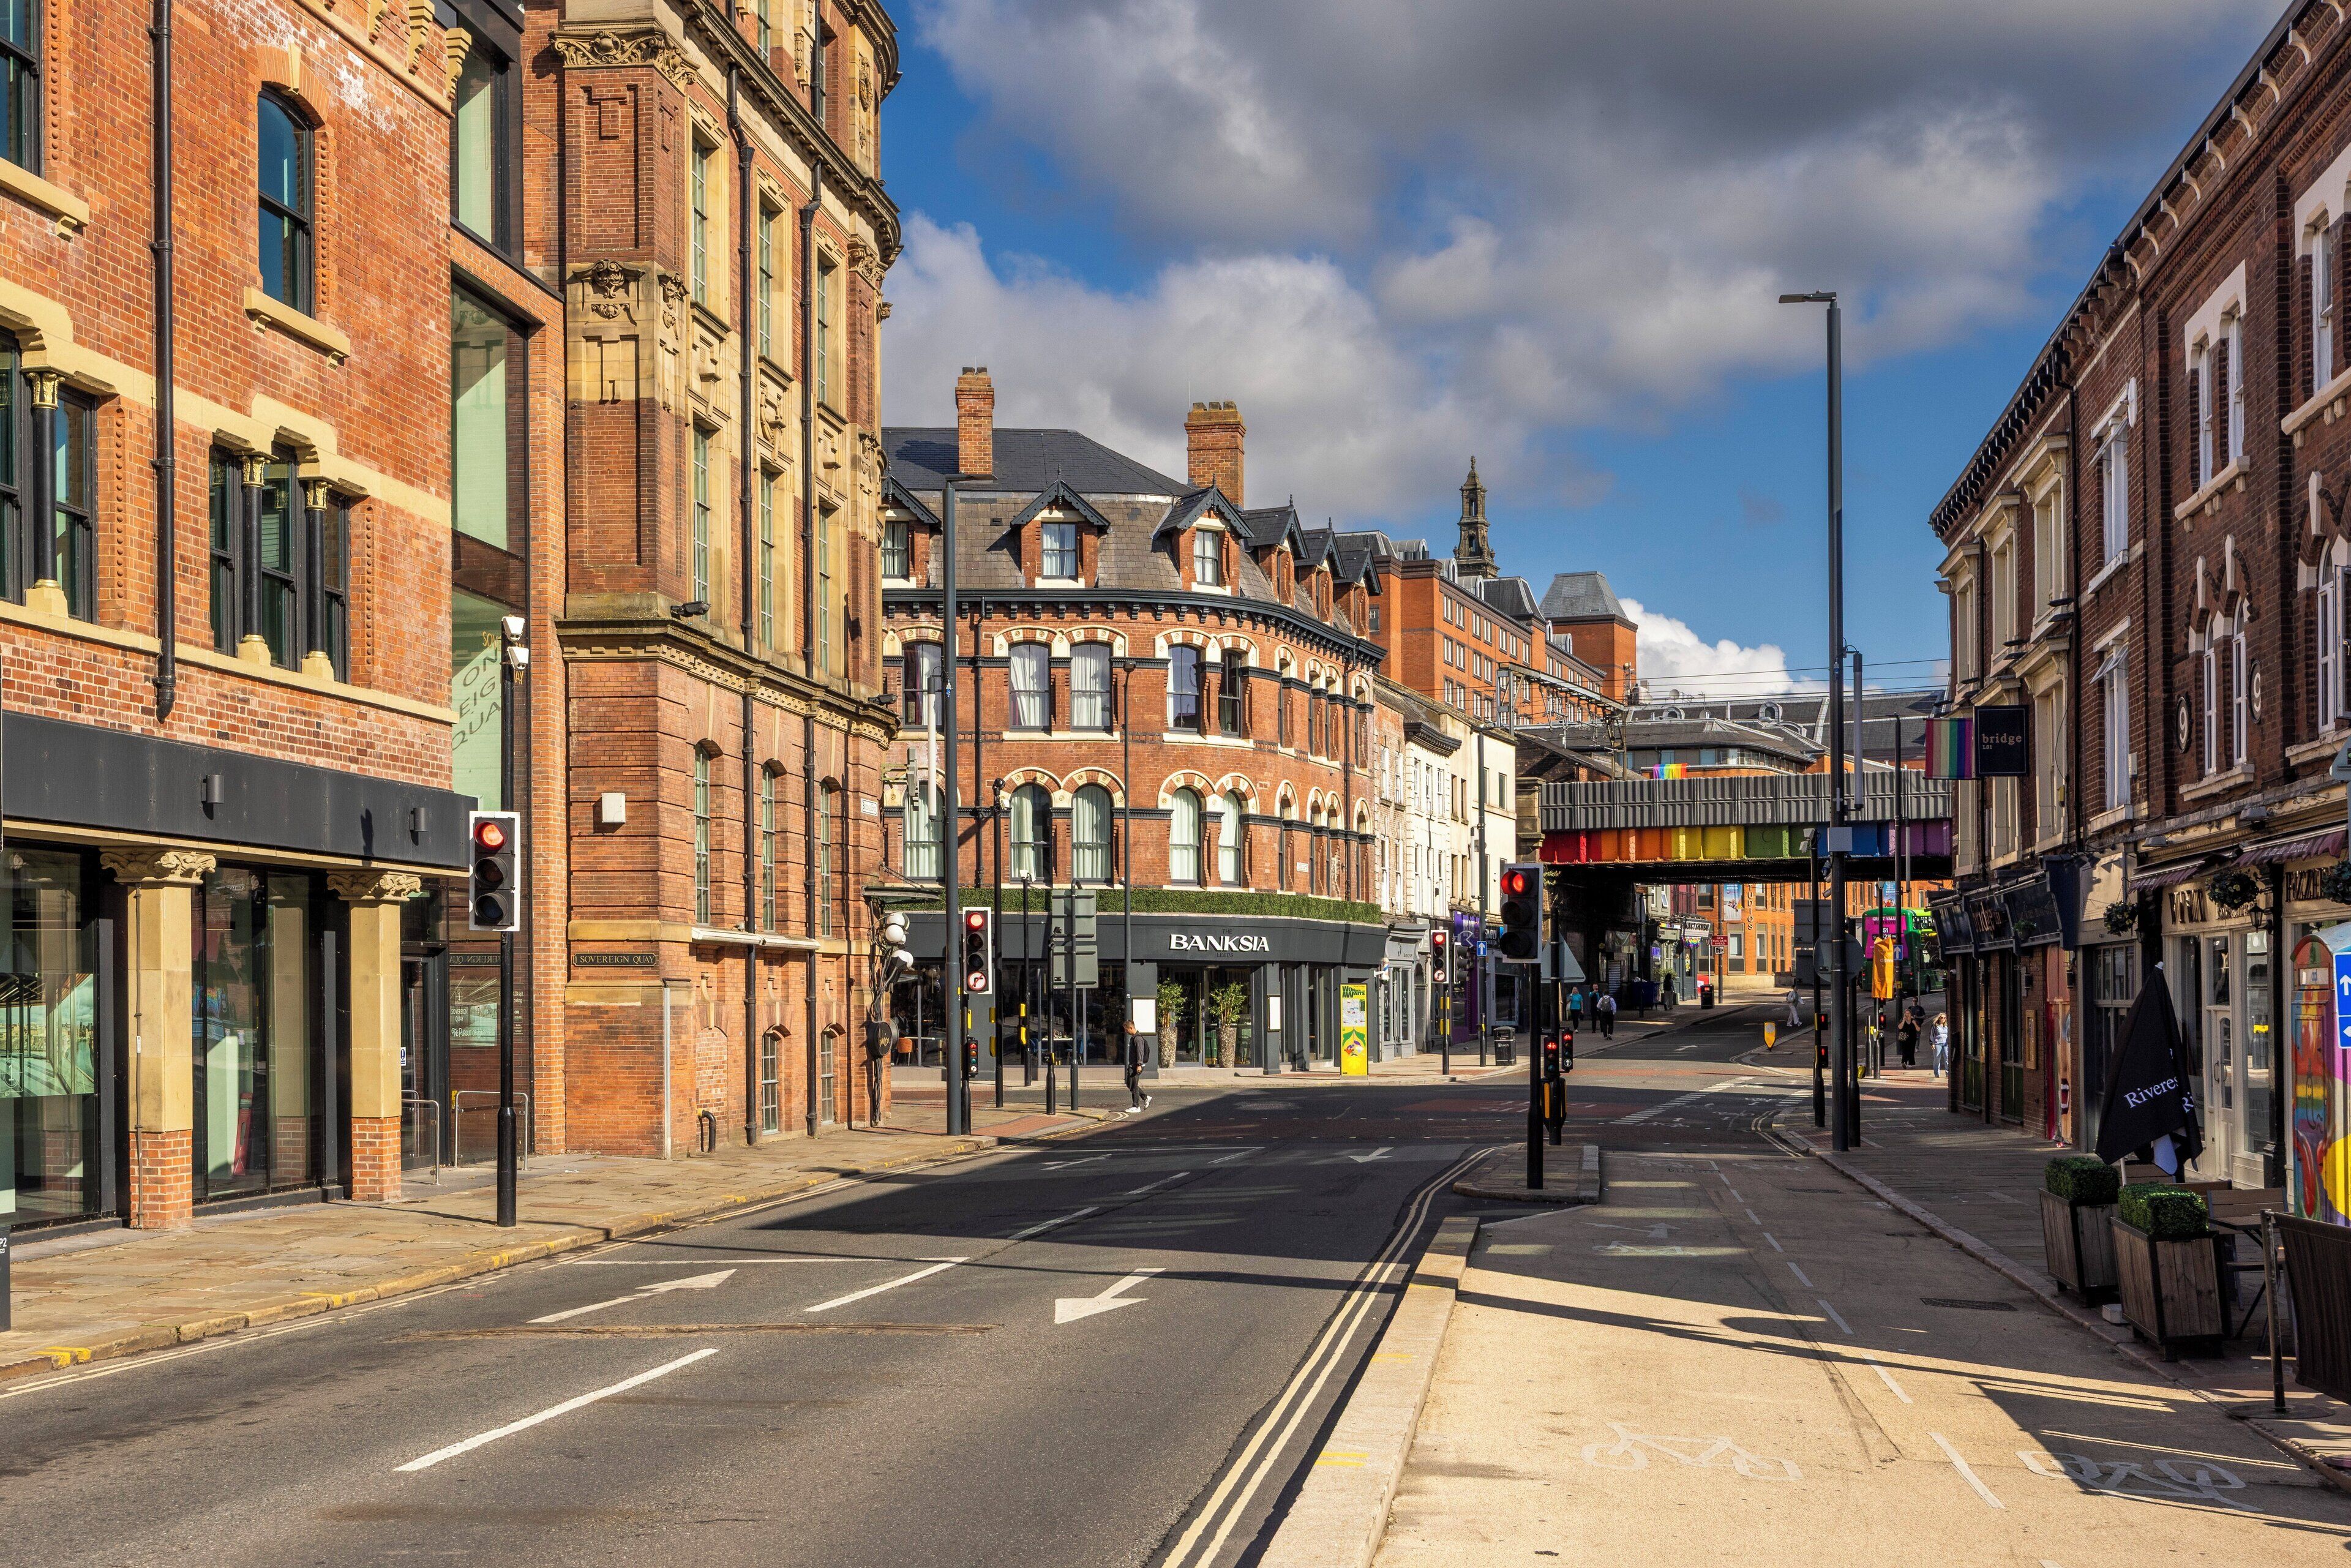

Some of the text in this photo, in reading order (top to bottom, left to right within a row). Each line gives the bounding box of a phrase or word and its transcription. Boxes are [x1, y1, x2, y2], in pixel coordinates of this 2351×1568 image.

[2253, 672, 2261, 712] 9
[452, 701, 501, 751] QUA
[1981, 733, 2022, 745] bridge
[2179, 706, 2189, 744] 9
[2285, 866, 2323, 902] PIZZE
[2169, 888, 2207, 925] VIVA
[580, 955, 631, 964] SOVEREIGN
[632, 955, 655, 965] QUAY
[1169, 934, 1270, 951] BANKSIA
